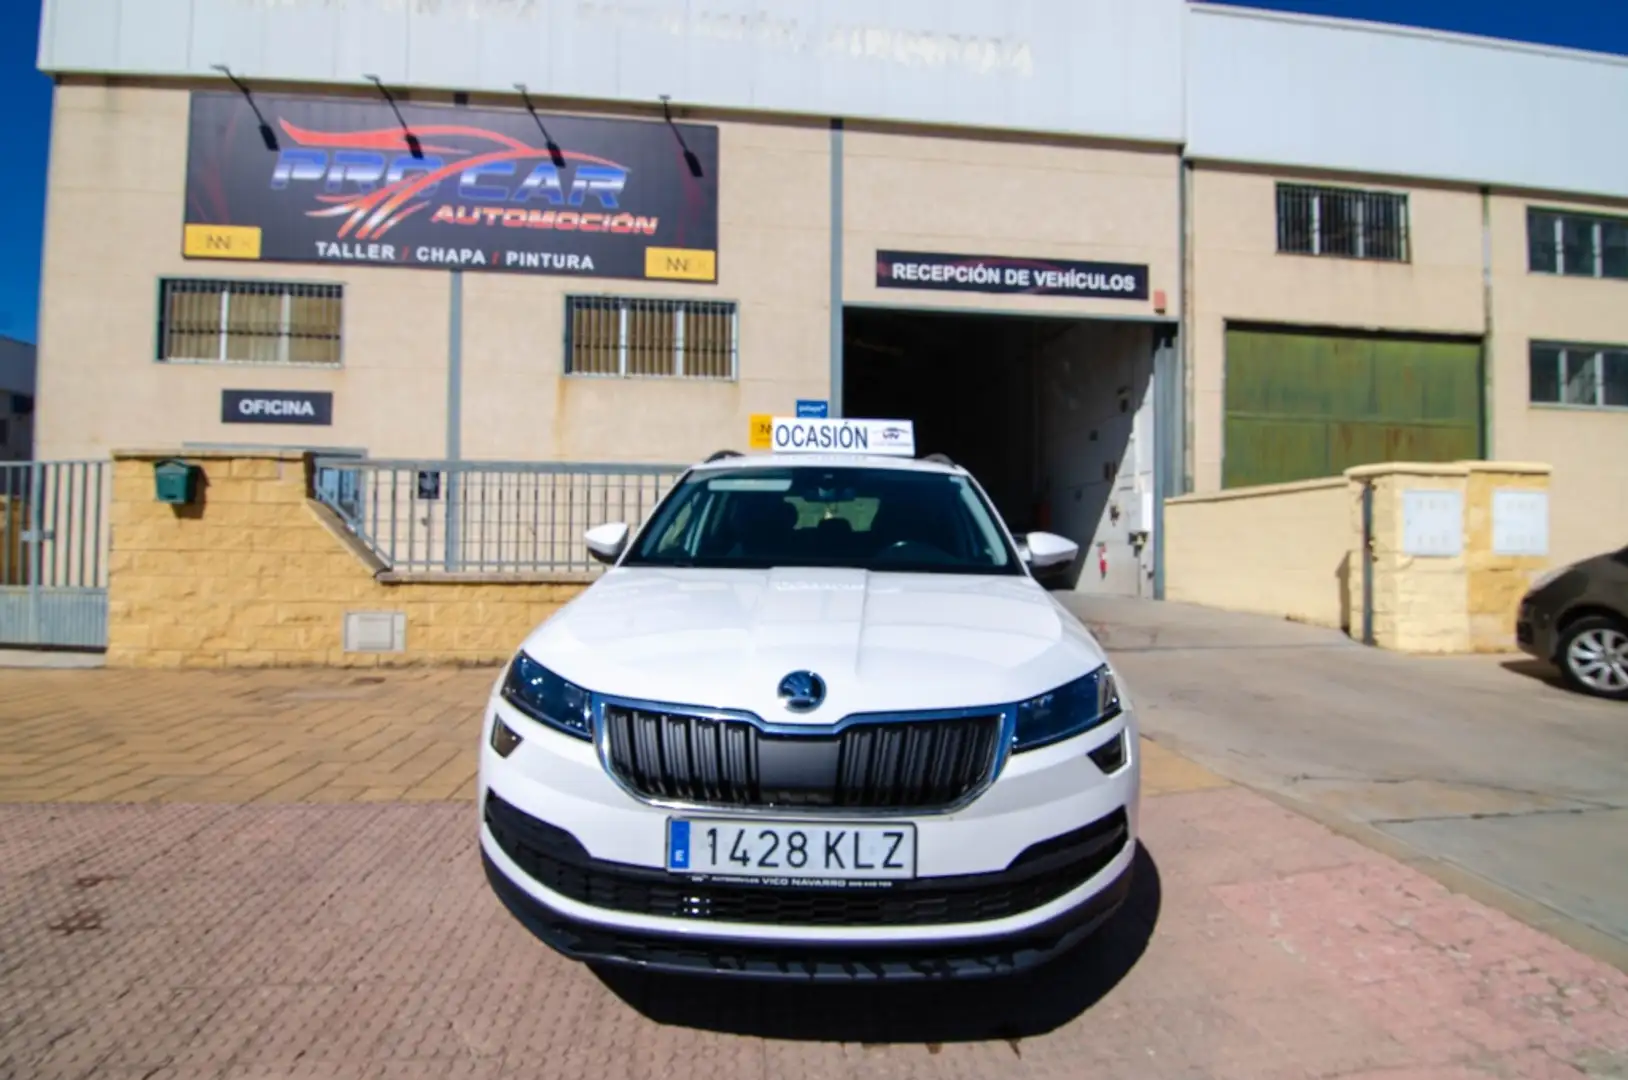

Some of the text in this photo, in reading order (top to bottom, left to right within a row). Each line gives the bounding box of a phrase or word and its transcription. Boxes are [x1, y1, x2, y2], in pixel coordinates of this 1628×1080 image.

[270, 148, 628, 208] PRO CAR
[431, 204, 659, 237] AUTOMOCIÓN
[315, 241, 396, 260] TALLER
[416, 246, 486, 265] CHAPA
[505, 251, 595, 270] PINTURA
[892, 261, 1136, 292] RECEPCIÓN DE VEHÍCULOS
[239, 399, 314, 416] OFICINA
[775, 422, 869, 450] OCASIÓN
[707, 828, 808, 869] 1428
[824, 831, 905, 870] KLZ
[761, 876, 789, 886] VICO
[791, 878, 846, 888] NAVARRO
